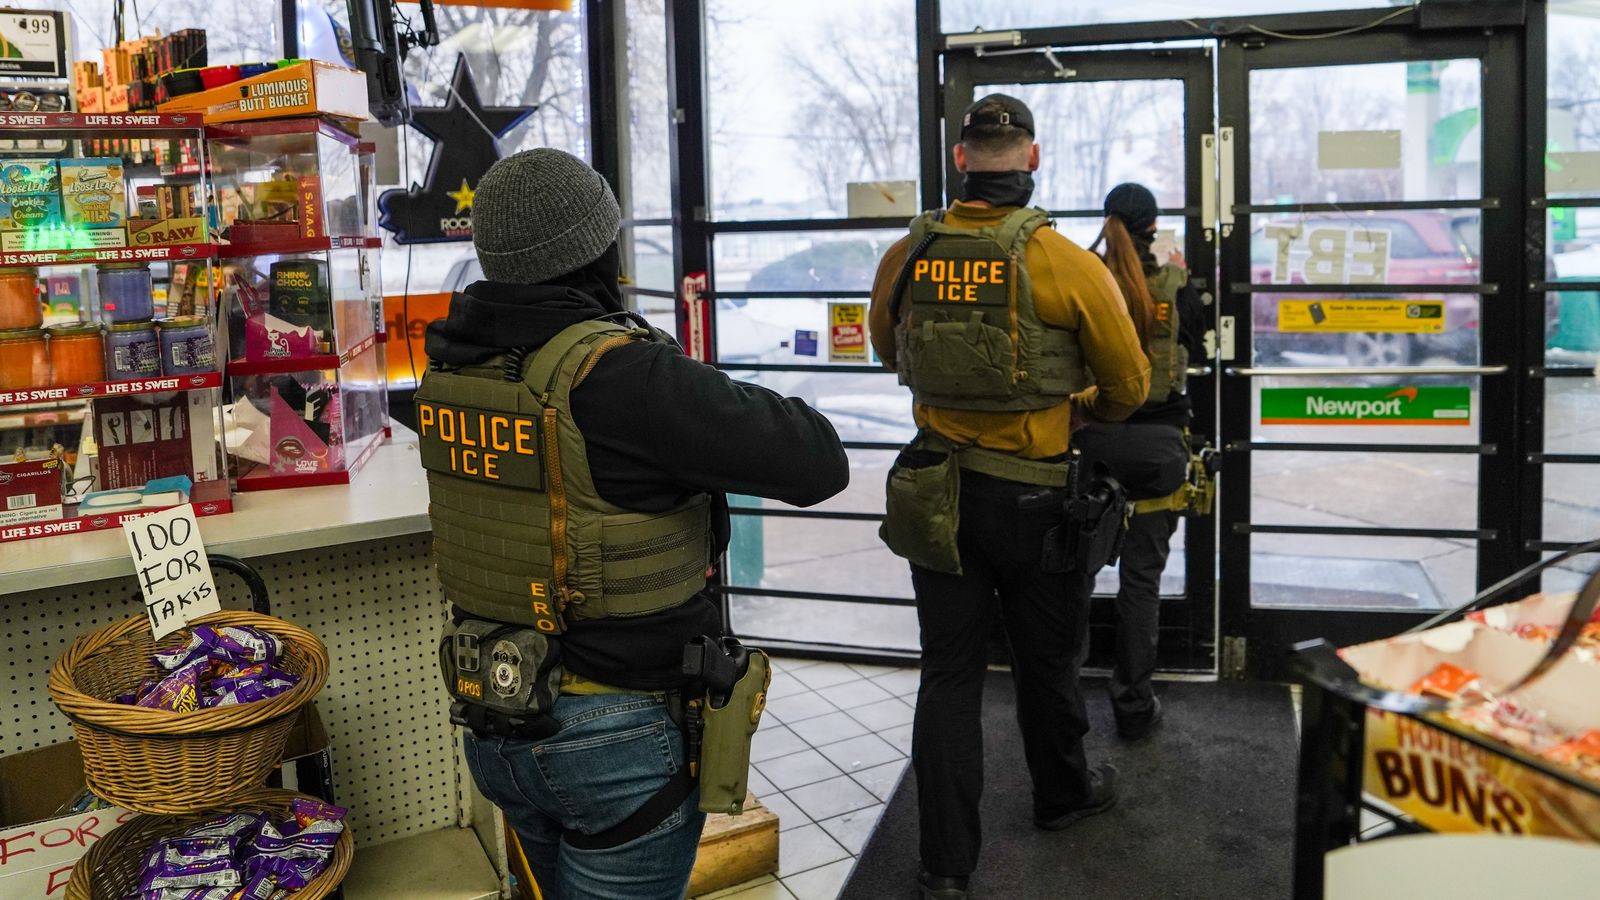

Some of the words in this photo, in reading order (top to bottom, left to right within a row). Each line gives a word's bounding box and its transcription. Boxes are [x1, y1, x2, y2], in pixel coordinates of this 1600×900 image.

[251, 78, 308, 97] LUMINOUS
[239, 97, 266, 113] BUTT
[268, 92, 310, 110] BUCKET
[9, 115, 48, 125] SWEET
[85, 115, 109, 125] LIFE
[110, 115, 123, 125] IS
[125, 115, 161, 125] SWEET
[150, 225, 199, 244] RAW
[4, 255, 18, 265] IS
[20, 253, 58, 264] SWEET
[95, 250, 118, 260] LIFE
[120, 250, 133, 259] IS
[135, 247, 170, 258] SWEET
[276, 271, 310, 280] RHINO
[914, 259, 1005, 284] POLICE
[276, 279, 313, 288] CHOCO
[938, 284, 978, 302] ICE
[15, 391, 29, 400] IS
[30, 388, 69, 400] SWEET
[105, 383, 129, 394] LIFE
[130, 382, 144, 392] IS
[145, 379, 180, 391] SWEET
[1306, 396, 1402, 419] Newport
[419, 404, 535, 455] POLICE
[450, 446, 500, 480] ICE
[16, 469, 52, 478] CIGARILLOS
[1, 527, 27, 539] LIFE
[28, 526, 42, 536] IS
[44, 520, 82, 534] SWEET
[140, 549, 202, 596] FOR
[530, 582, 556, 632] ERO
[464, 680, 481, 697] POS
[1374, 750, 1530, 836] BUNS
[0, 816, 103, 866] FOR
